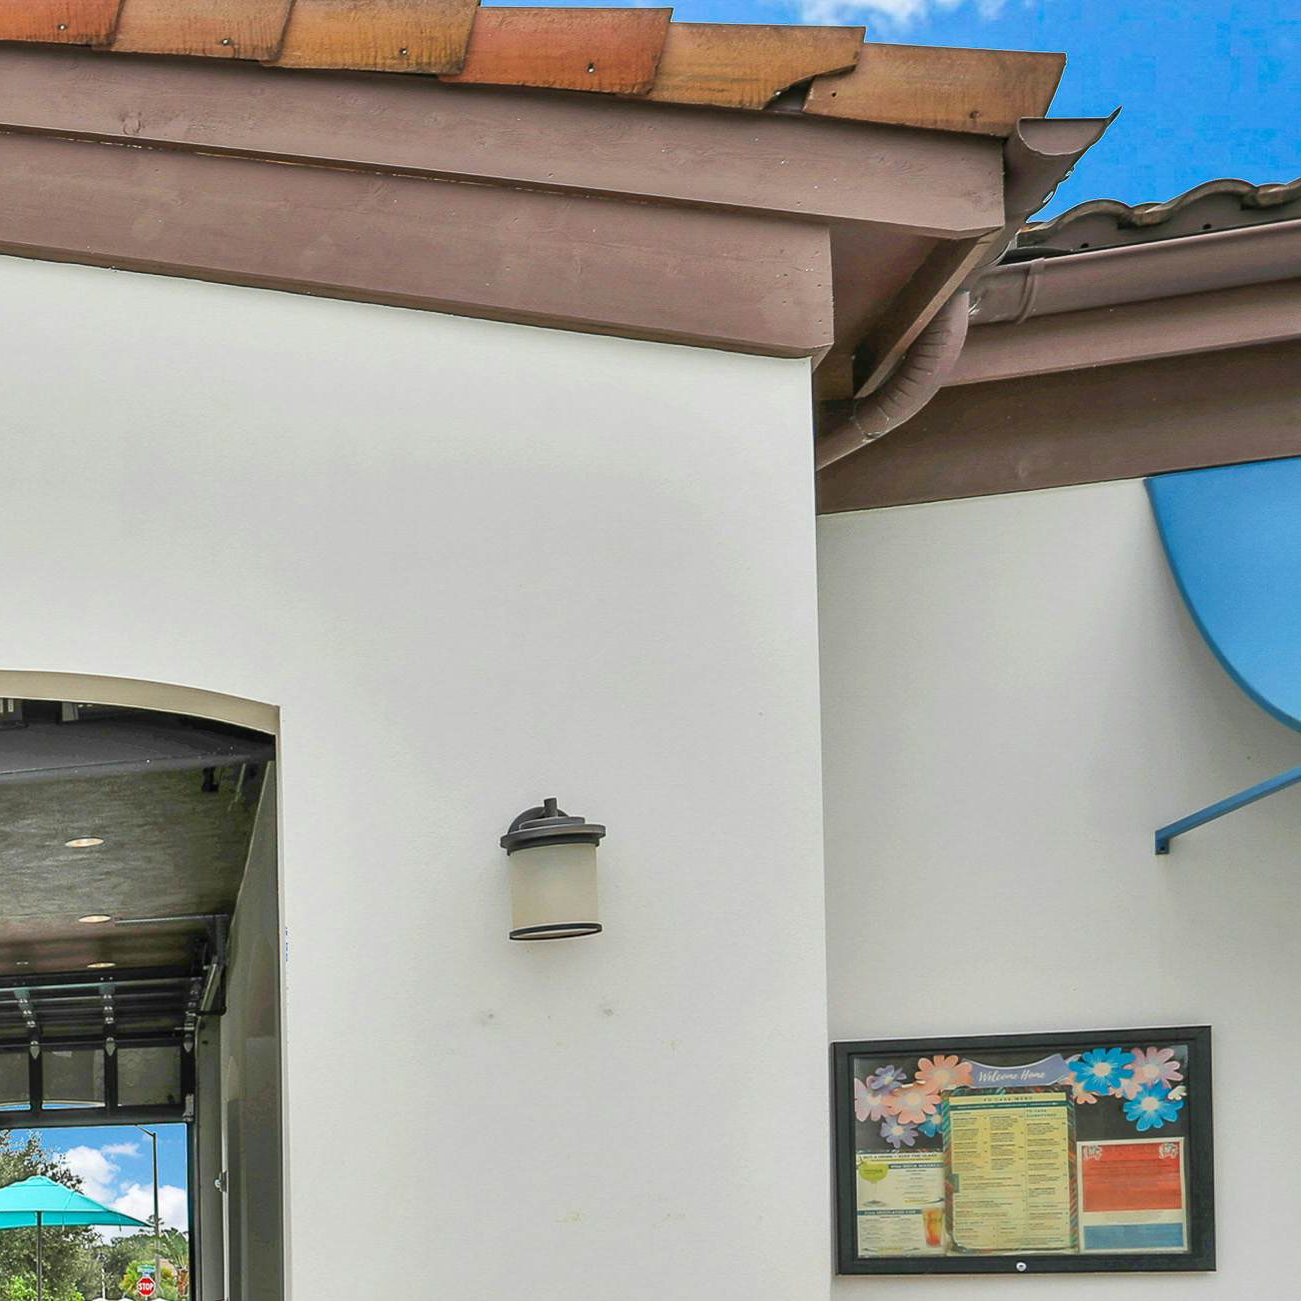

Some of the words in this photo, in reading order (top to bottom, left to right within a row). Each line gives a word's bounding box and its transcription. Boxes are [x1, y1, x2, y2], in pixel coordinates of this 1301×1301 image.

[978, 1070, 1018, 1082] Welcome
[1021, 1069, 1046, 1080] Home
[138, 1282, 154, 1291] STOP
